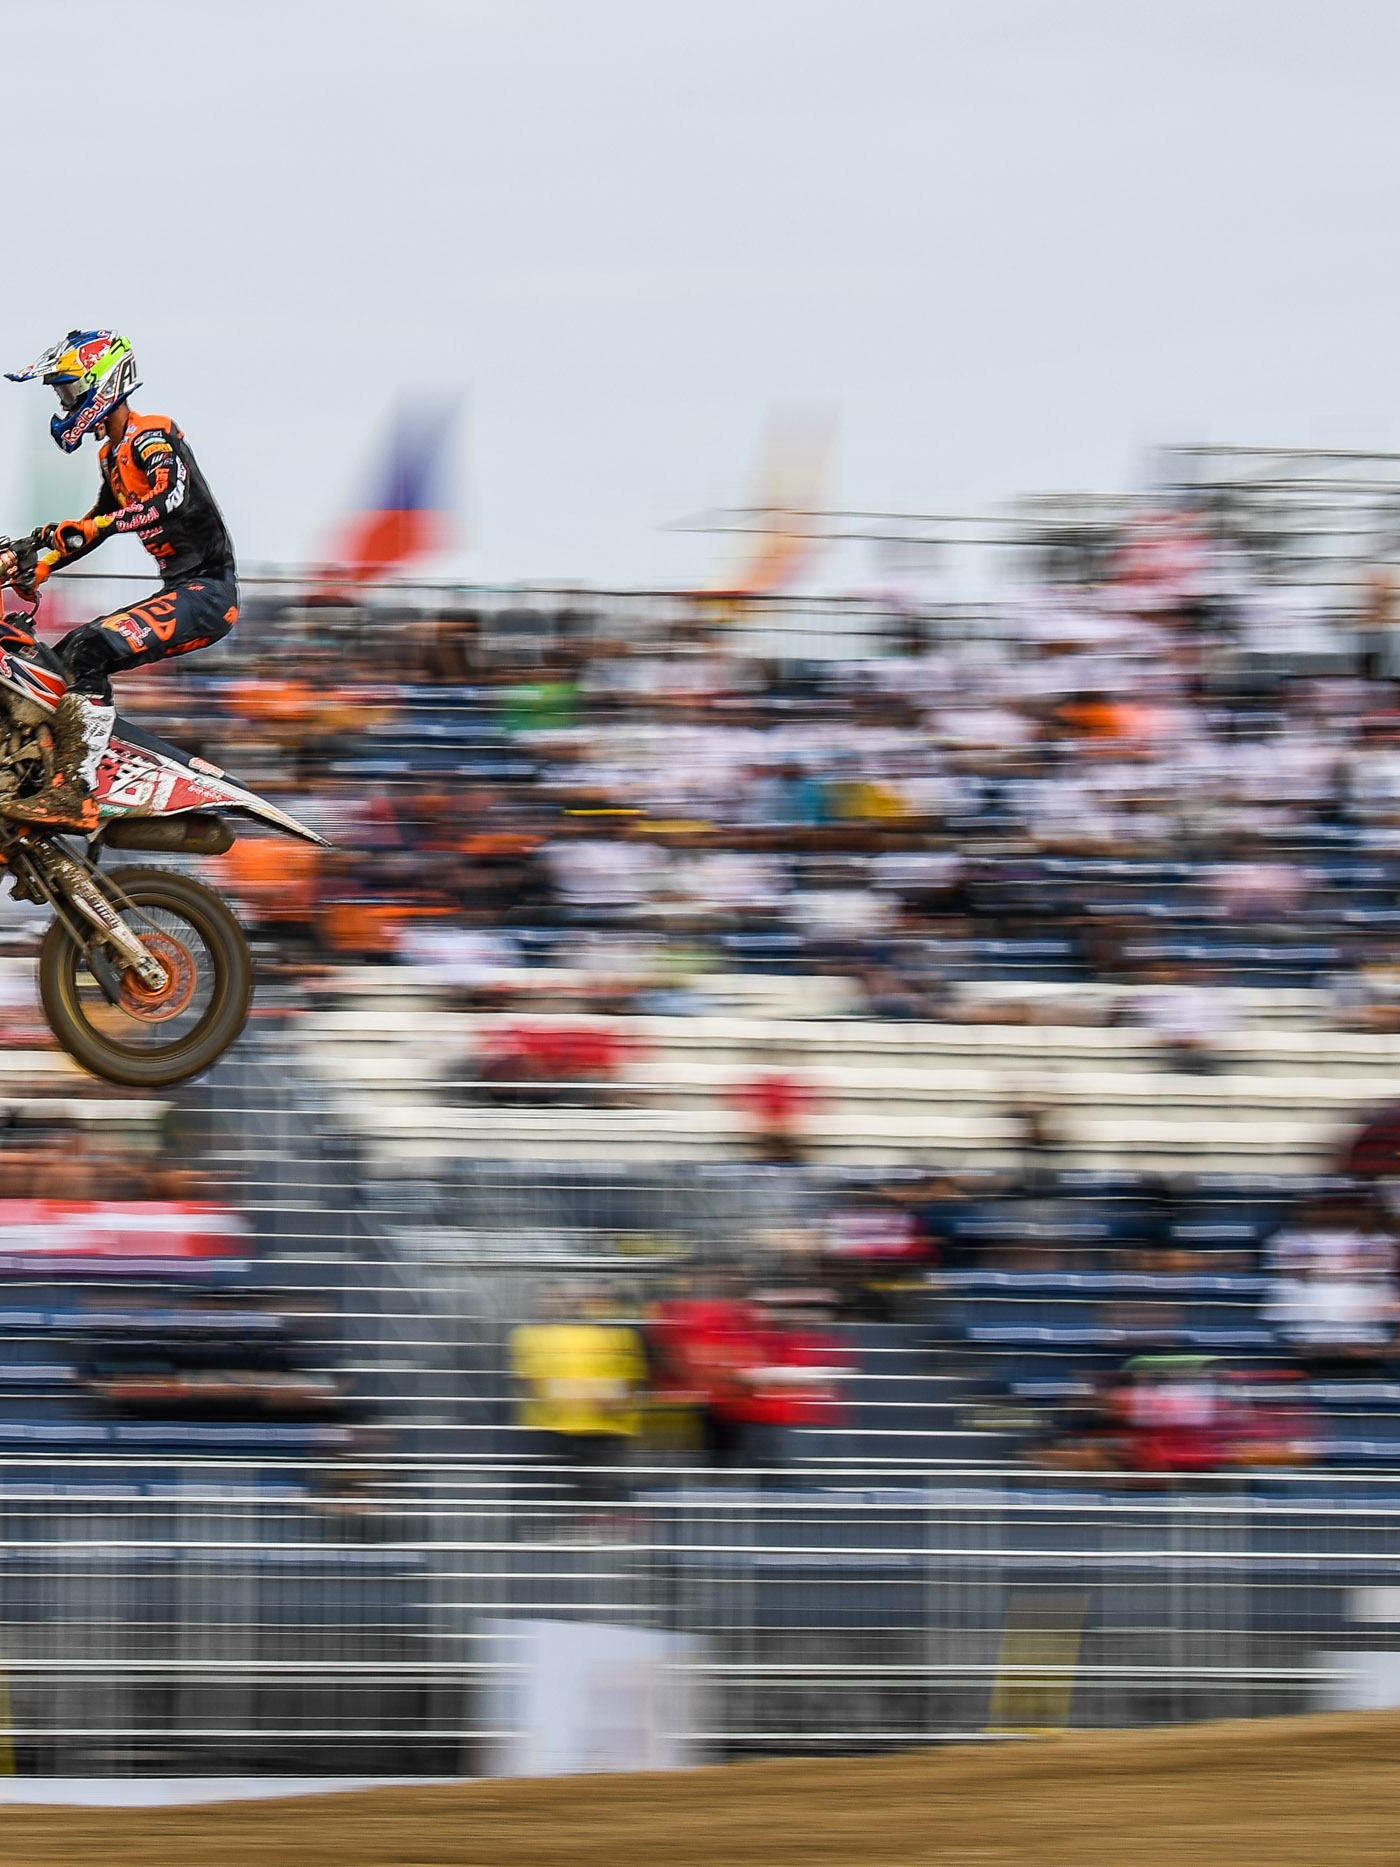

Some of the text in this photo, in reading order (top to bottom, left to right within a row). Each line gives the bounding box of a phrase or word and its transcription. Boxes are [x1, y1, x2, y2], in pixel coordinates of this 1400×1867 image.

[61, 391, 109, 446] Red Bull
[106, 763, 180, 811] 61
